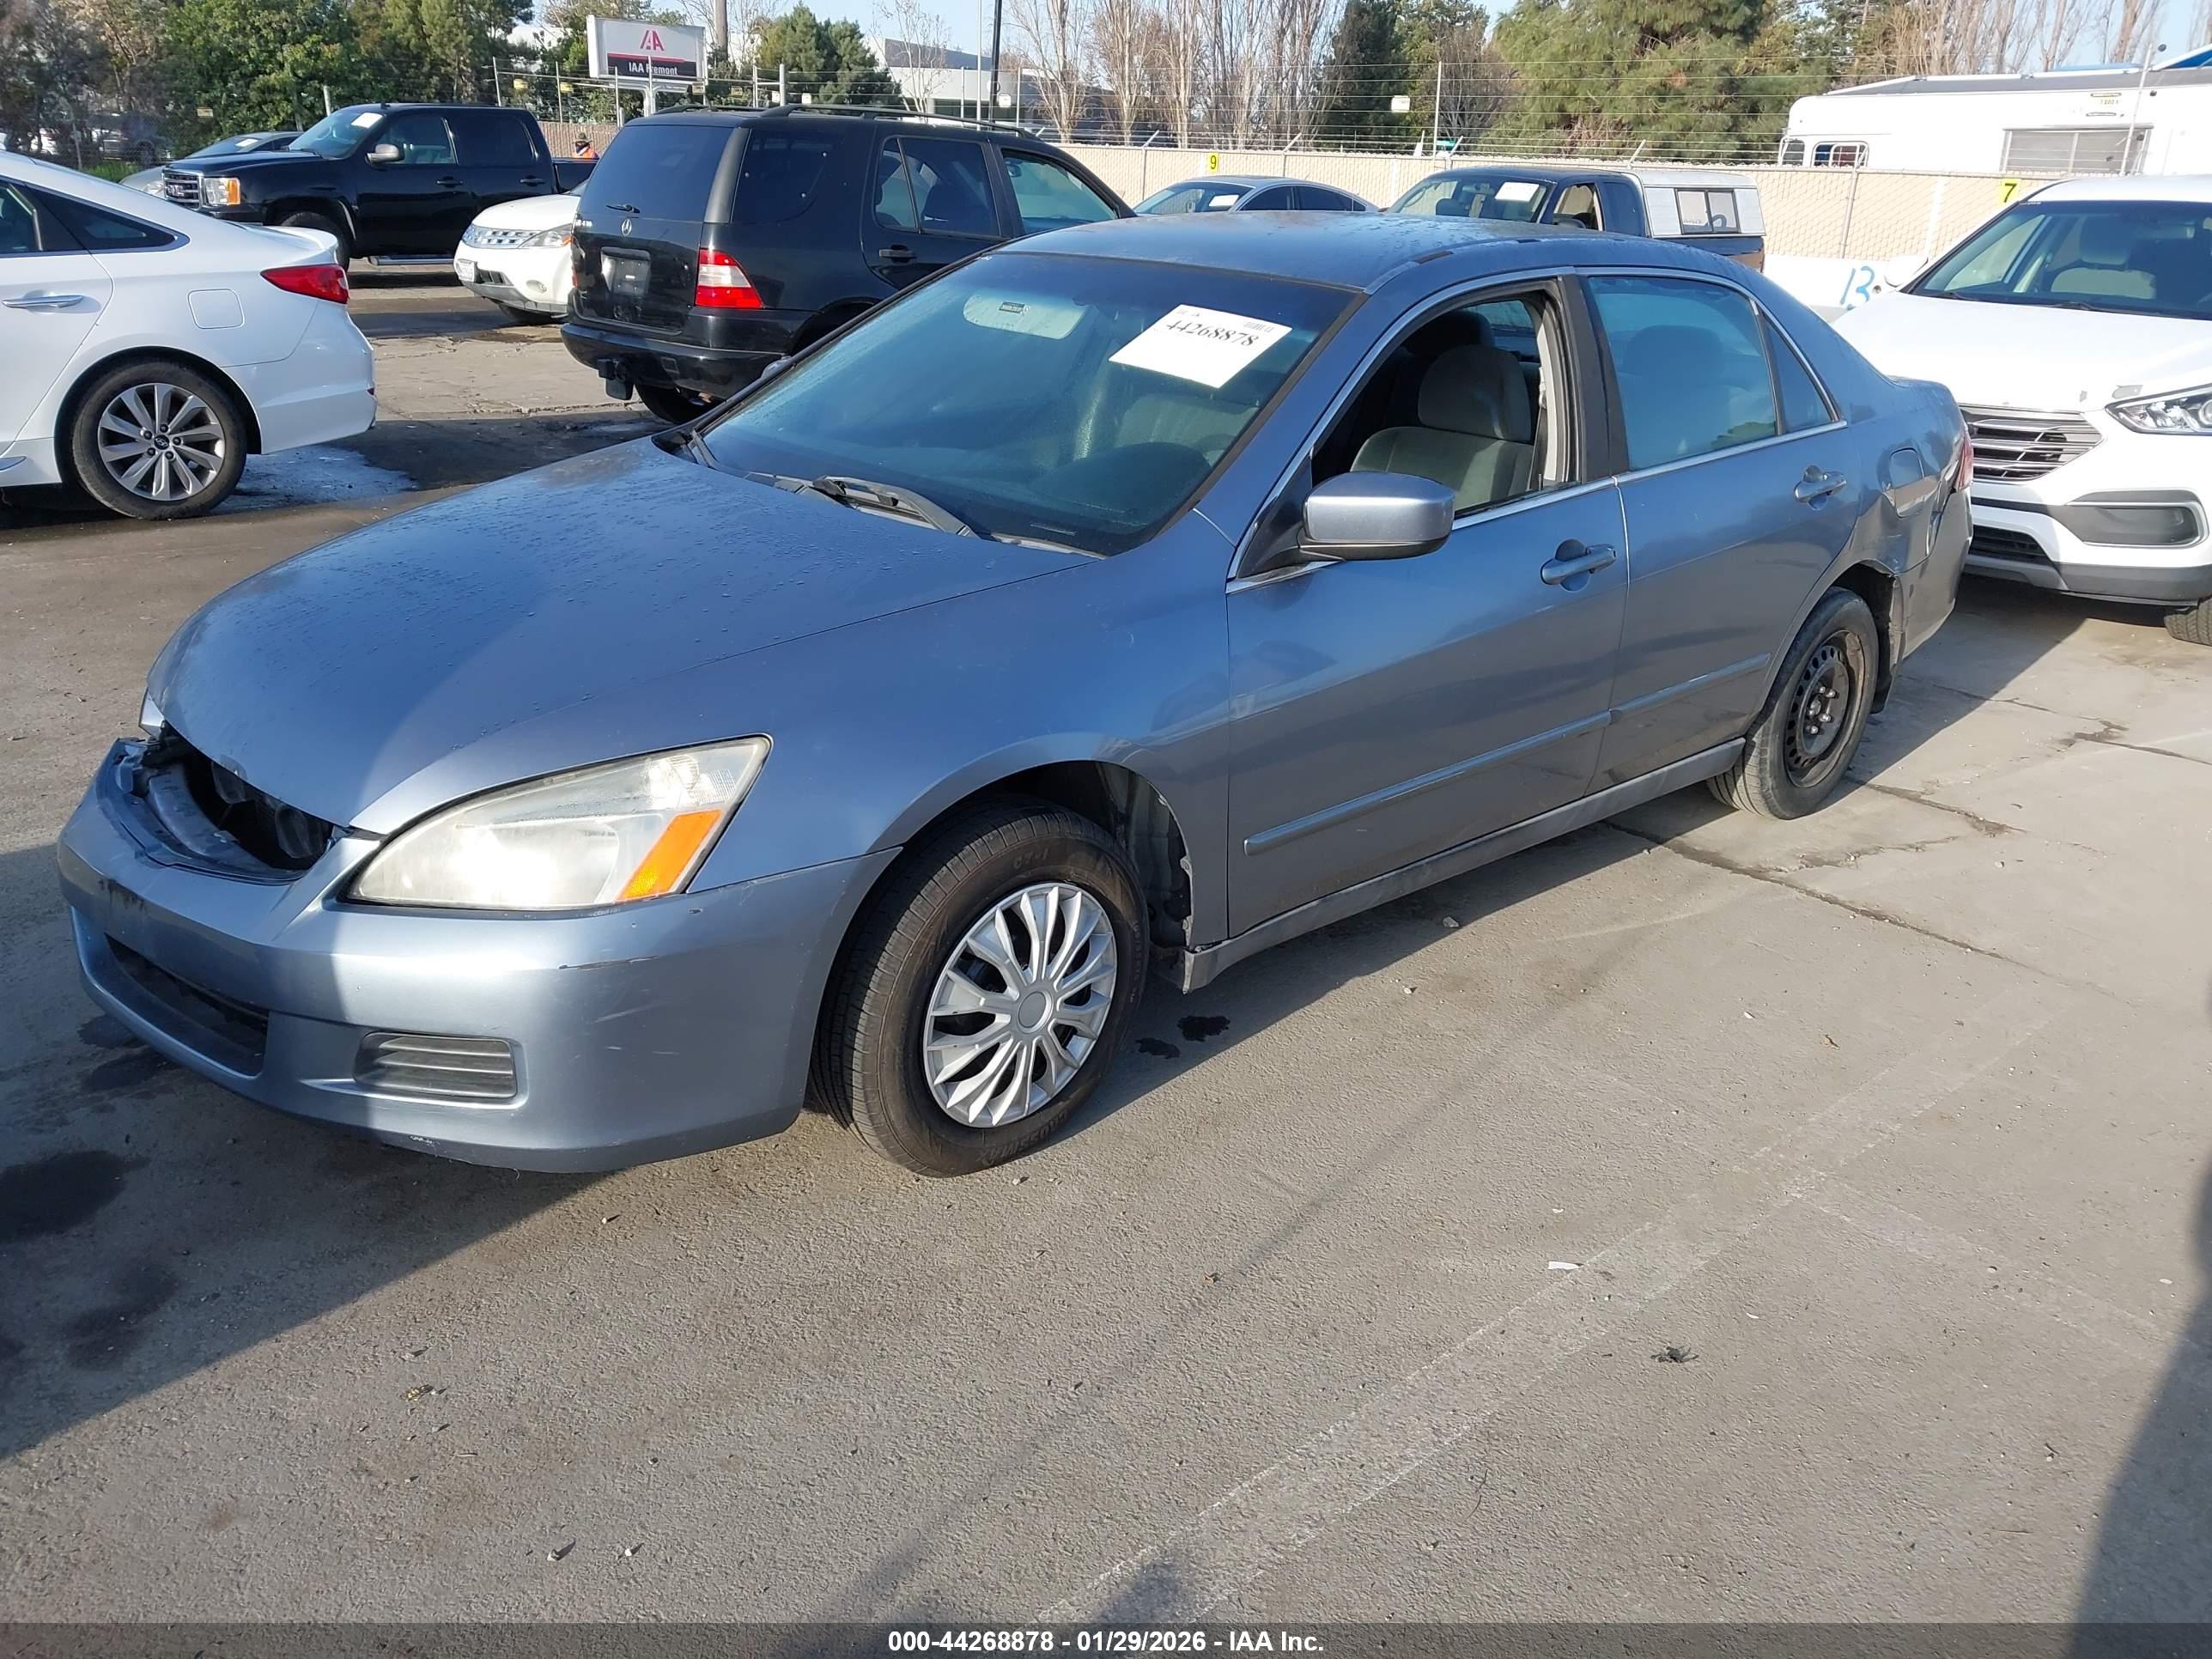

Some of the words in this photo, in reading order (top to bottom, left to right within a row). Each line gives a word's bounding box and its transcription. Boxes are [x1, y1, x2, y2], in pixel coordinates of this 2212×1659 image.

[629, 62, 645, 73] IAA
[1210, 155, 1217, 170] 9
[2003, 182, 2018, 203] 7
[1166, 319, 1260, 347] 44268878
